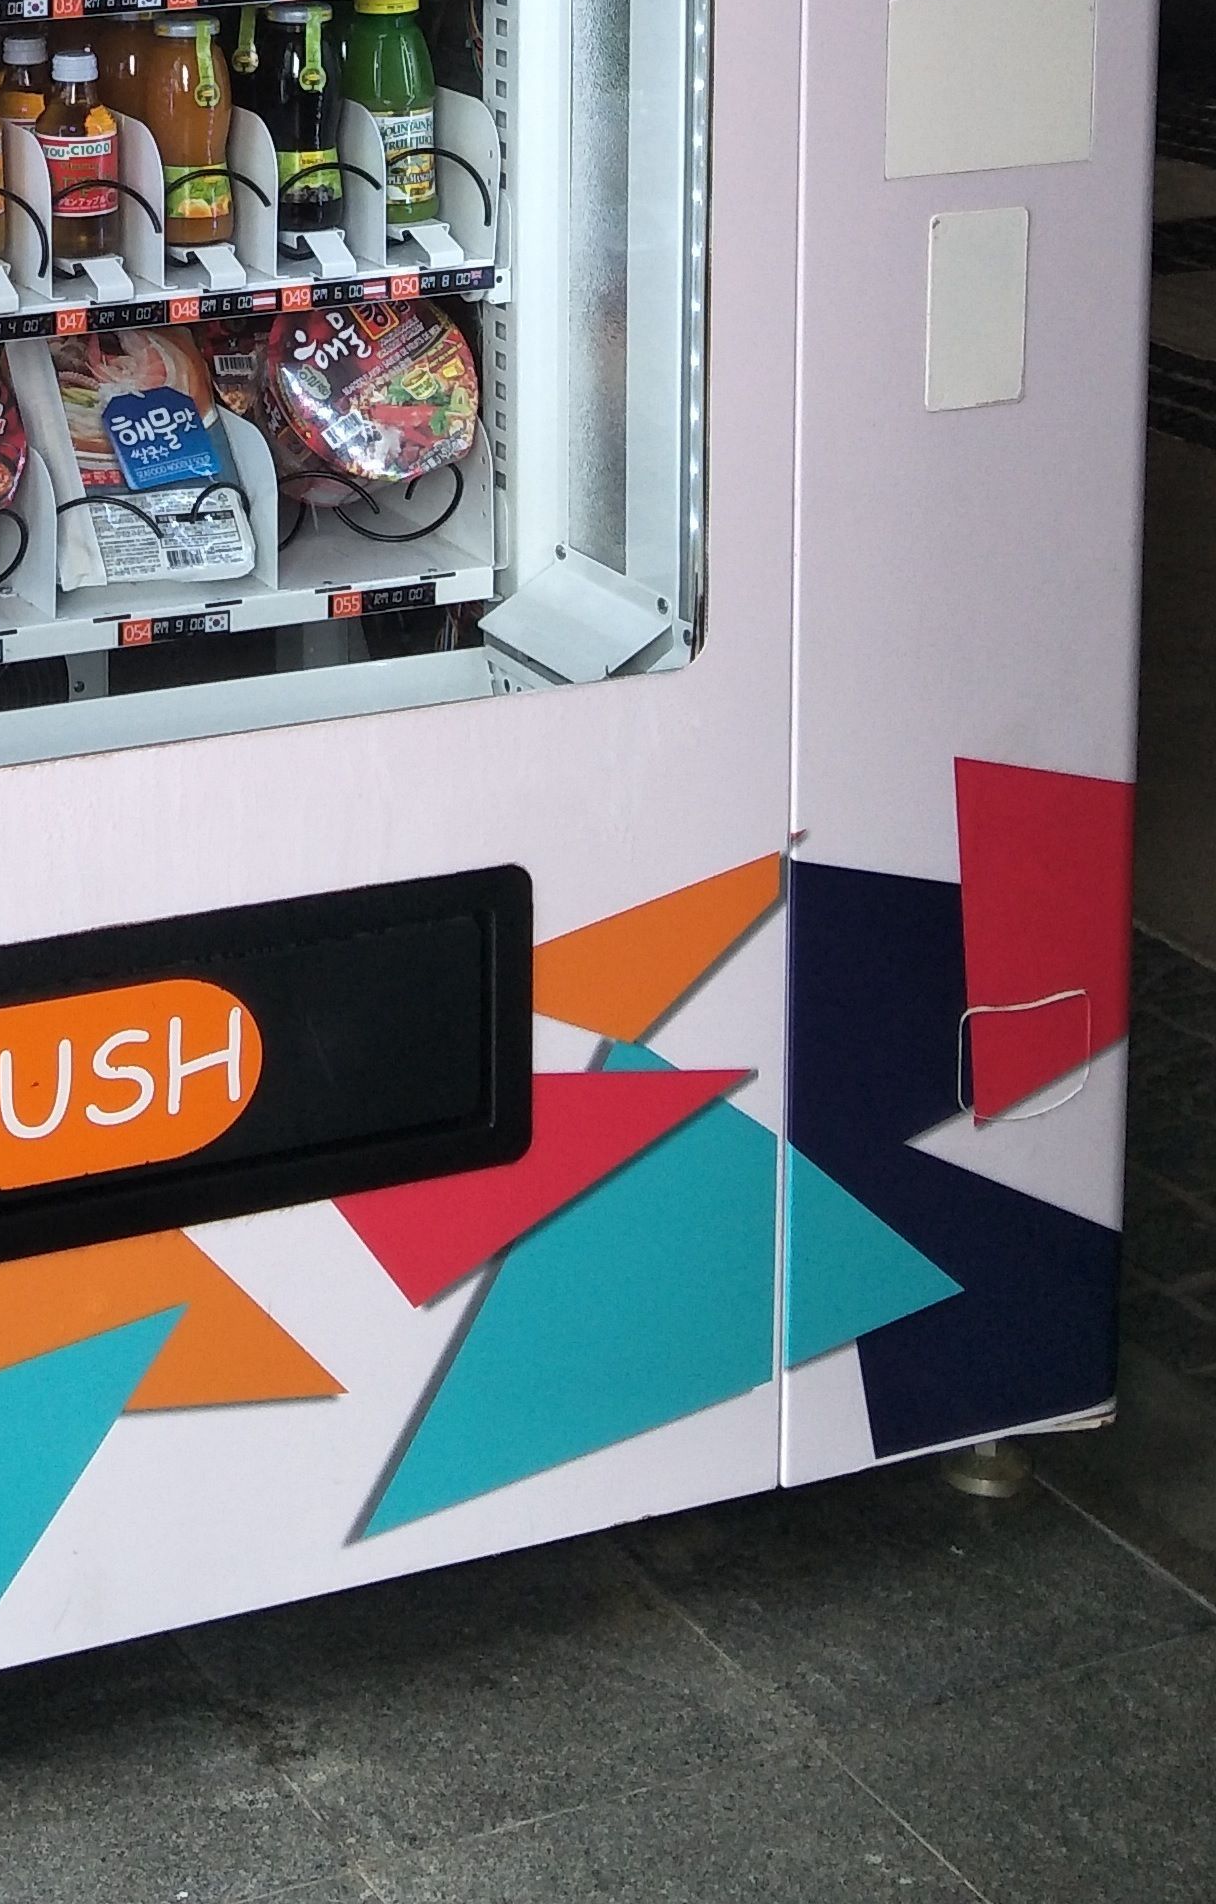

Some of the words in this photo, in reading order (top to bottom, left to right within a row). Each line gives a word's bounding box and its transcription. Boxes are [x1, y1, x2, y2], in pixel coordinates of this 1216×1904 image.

[392, 278, 419, 296] 050
[282, 289, 311, 308] 049
[172, 301, 199, 320] 048
[58, 312, 85, 332] 047
[111, 407, 197, 449] 해물맛
[130, 445, 170, 464] 쌀국수
[334, 596, 360, 614] 055
[124, 623, 151, 642] 054
